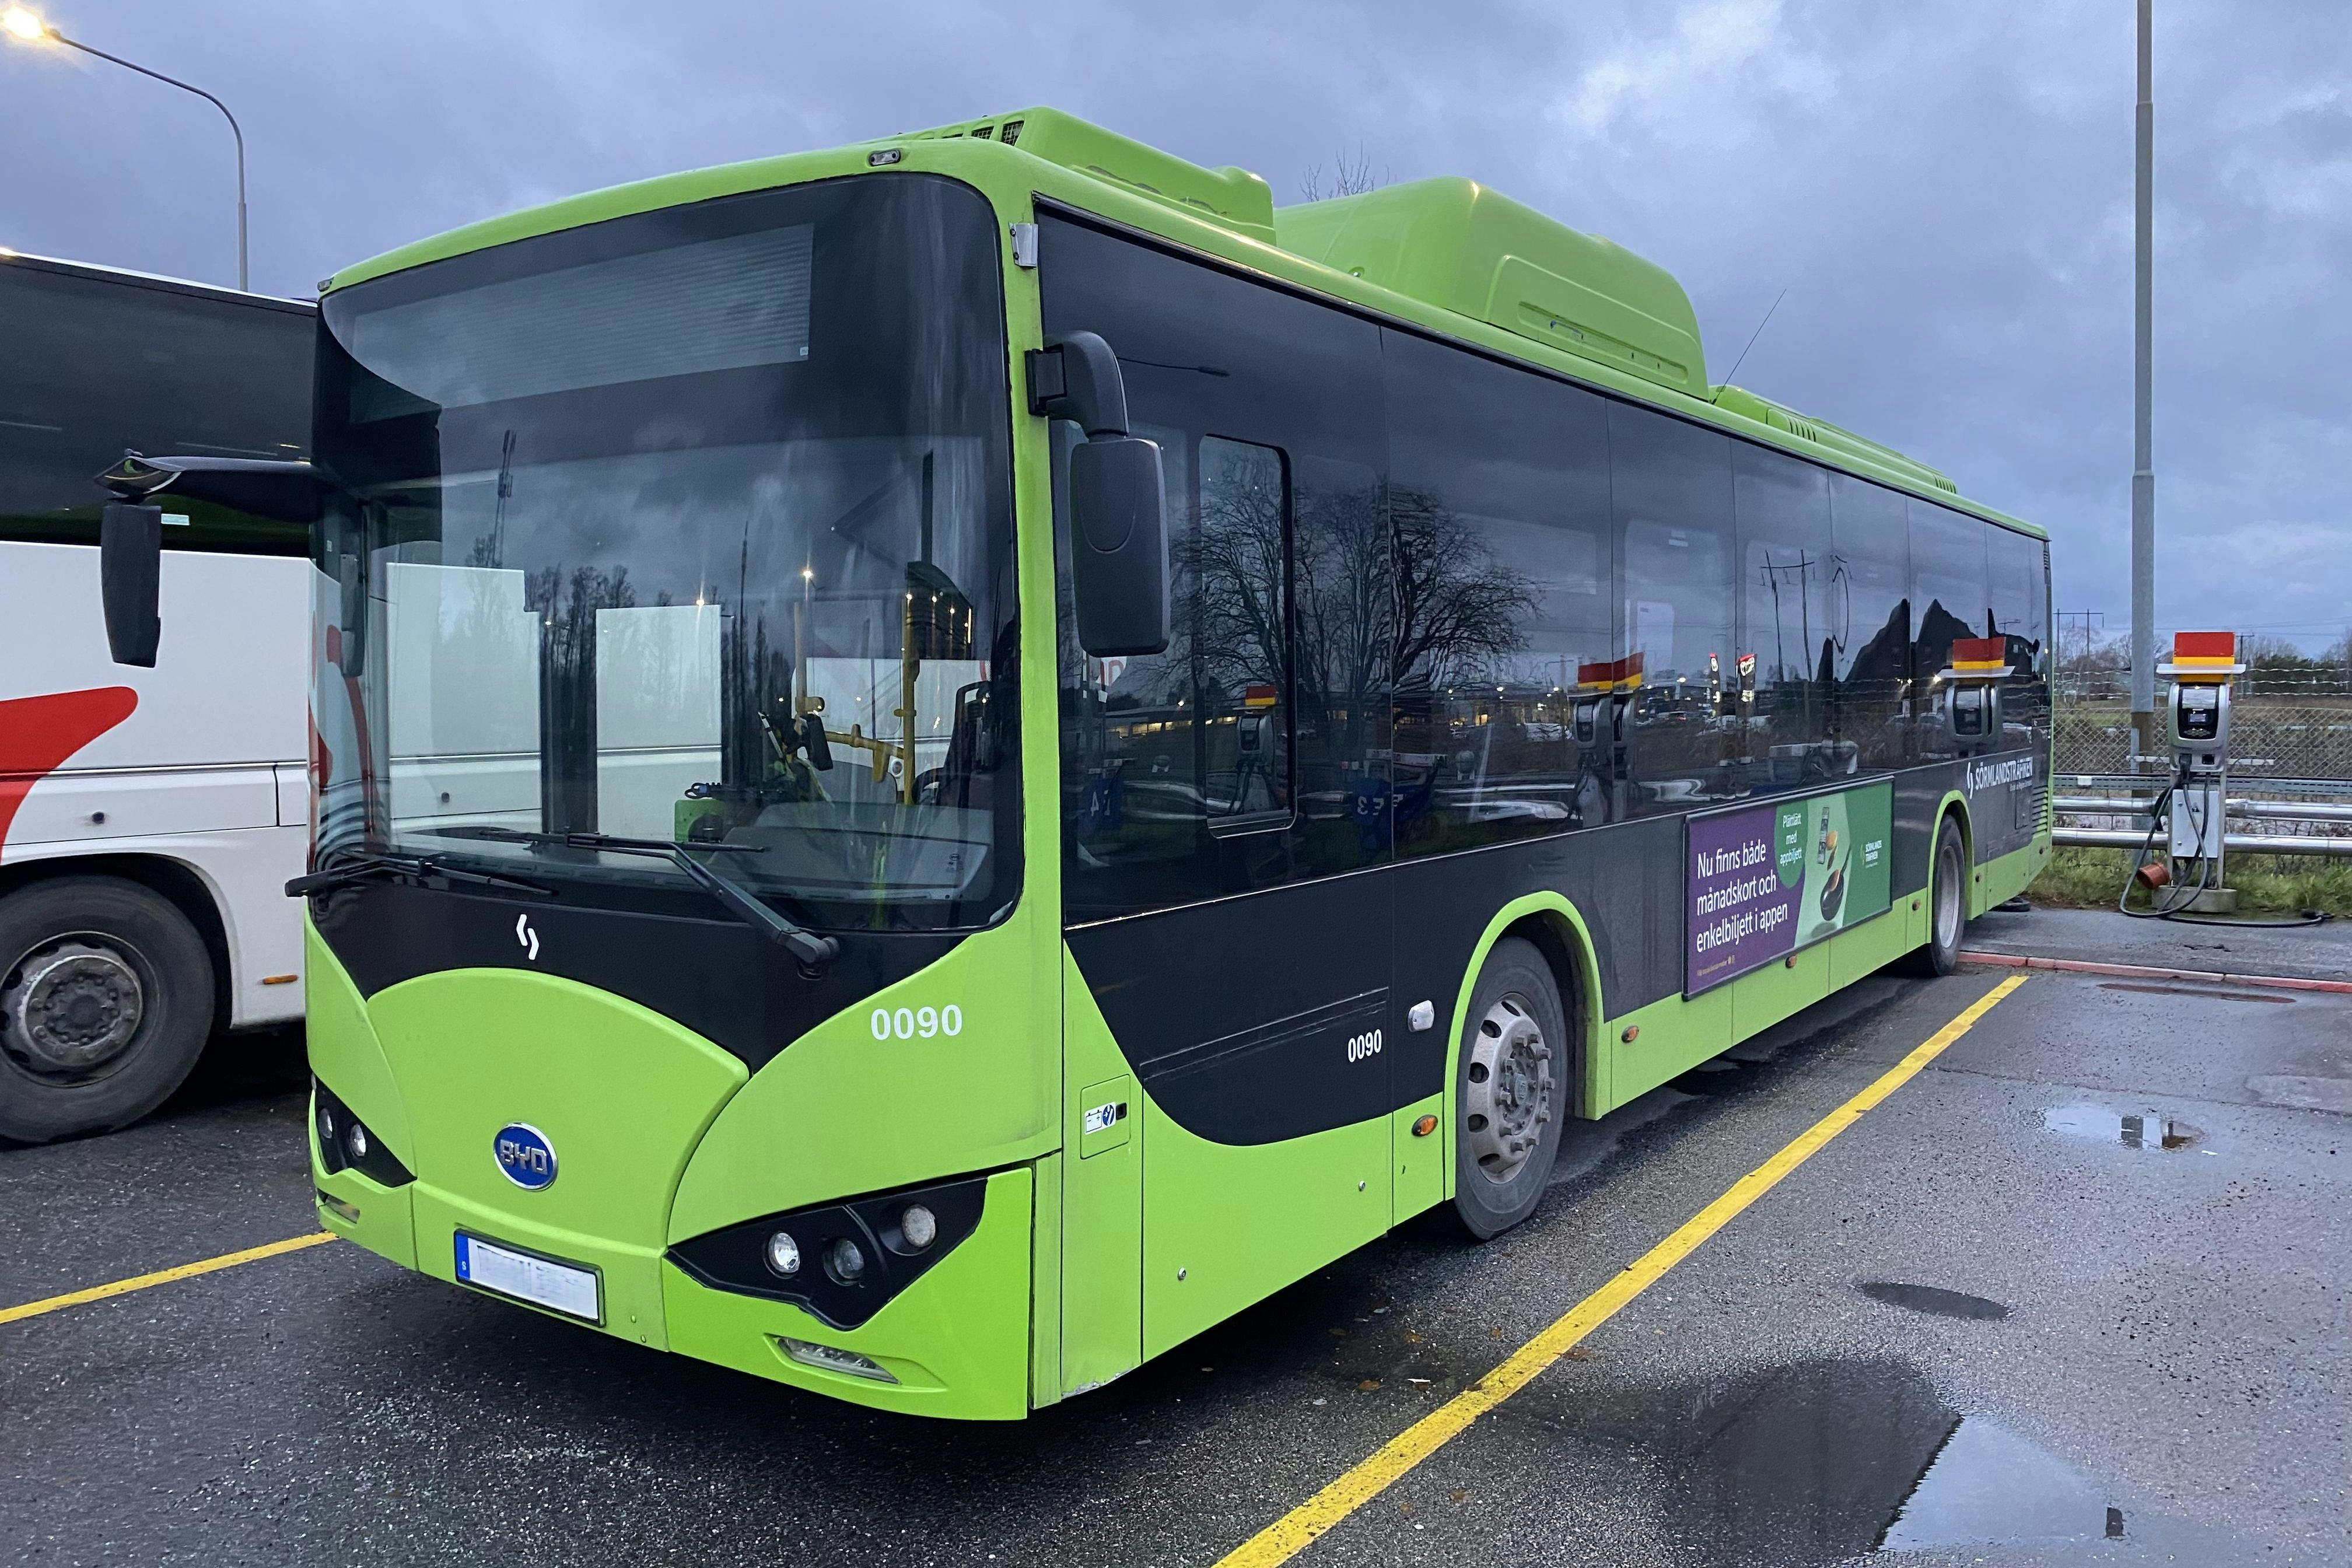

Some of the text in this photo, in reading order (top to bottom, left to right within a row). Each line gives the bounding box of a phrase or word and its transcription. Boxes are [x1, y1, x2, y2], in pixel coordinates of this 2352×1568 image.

[1786, 830, 1797, 845] med
[1698, 839, 1766, 879] Nu finns både
[1697, 869, 1777, 916] månadskort och
[1696, 903, 1788, 953] enkelbiljett i appen
[871, 1004, 963, 1041] 0090
[1348, 1028, 1382, 1063] 0090
[500, 1139, 548, 1175] BYD
[461, 1261, 467, 1270] S
